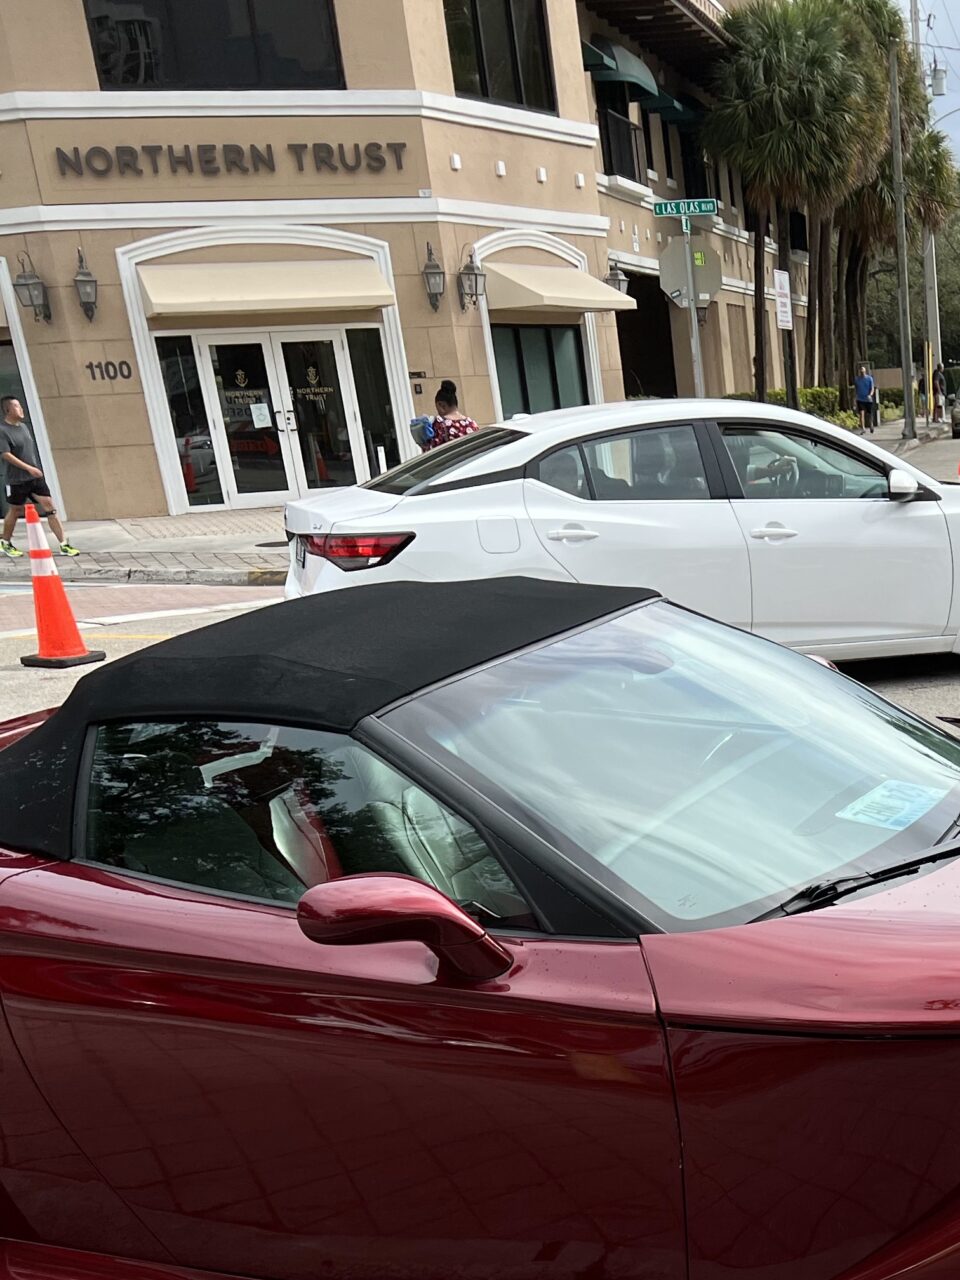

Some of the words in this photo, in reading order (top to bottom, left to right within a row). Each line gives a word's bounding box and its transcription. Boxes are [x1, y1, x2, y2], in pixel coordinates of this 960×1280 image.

[55, 143, 277, 177] NORTHERN
[287, 142, 407, 172] TRUST
[662, 202, 677, 215] LAS
[680, 202, 699, 214] OLAS
[701, 203, 713, 211] BLVD
[85, 361, 132, 381] 1100
[225, 389, 264, 397] NORTHERN
[297, 386, 334, 395] NORTHERN
[305, 393, 327, 401] TRUST
